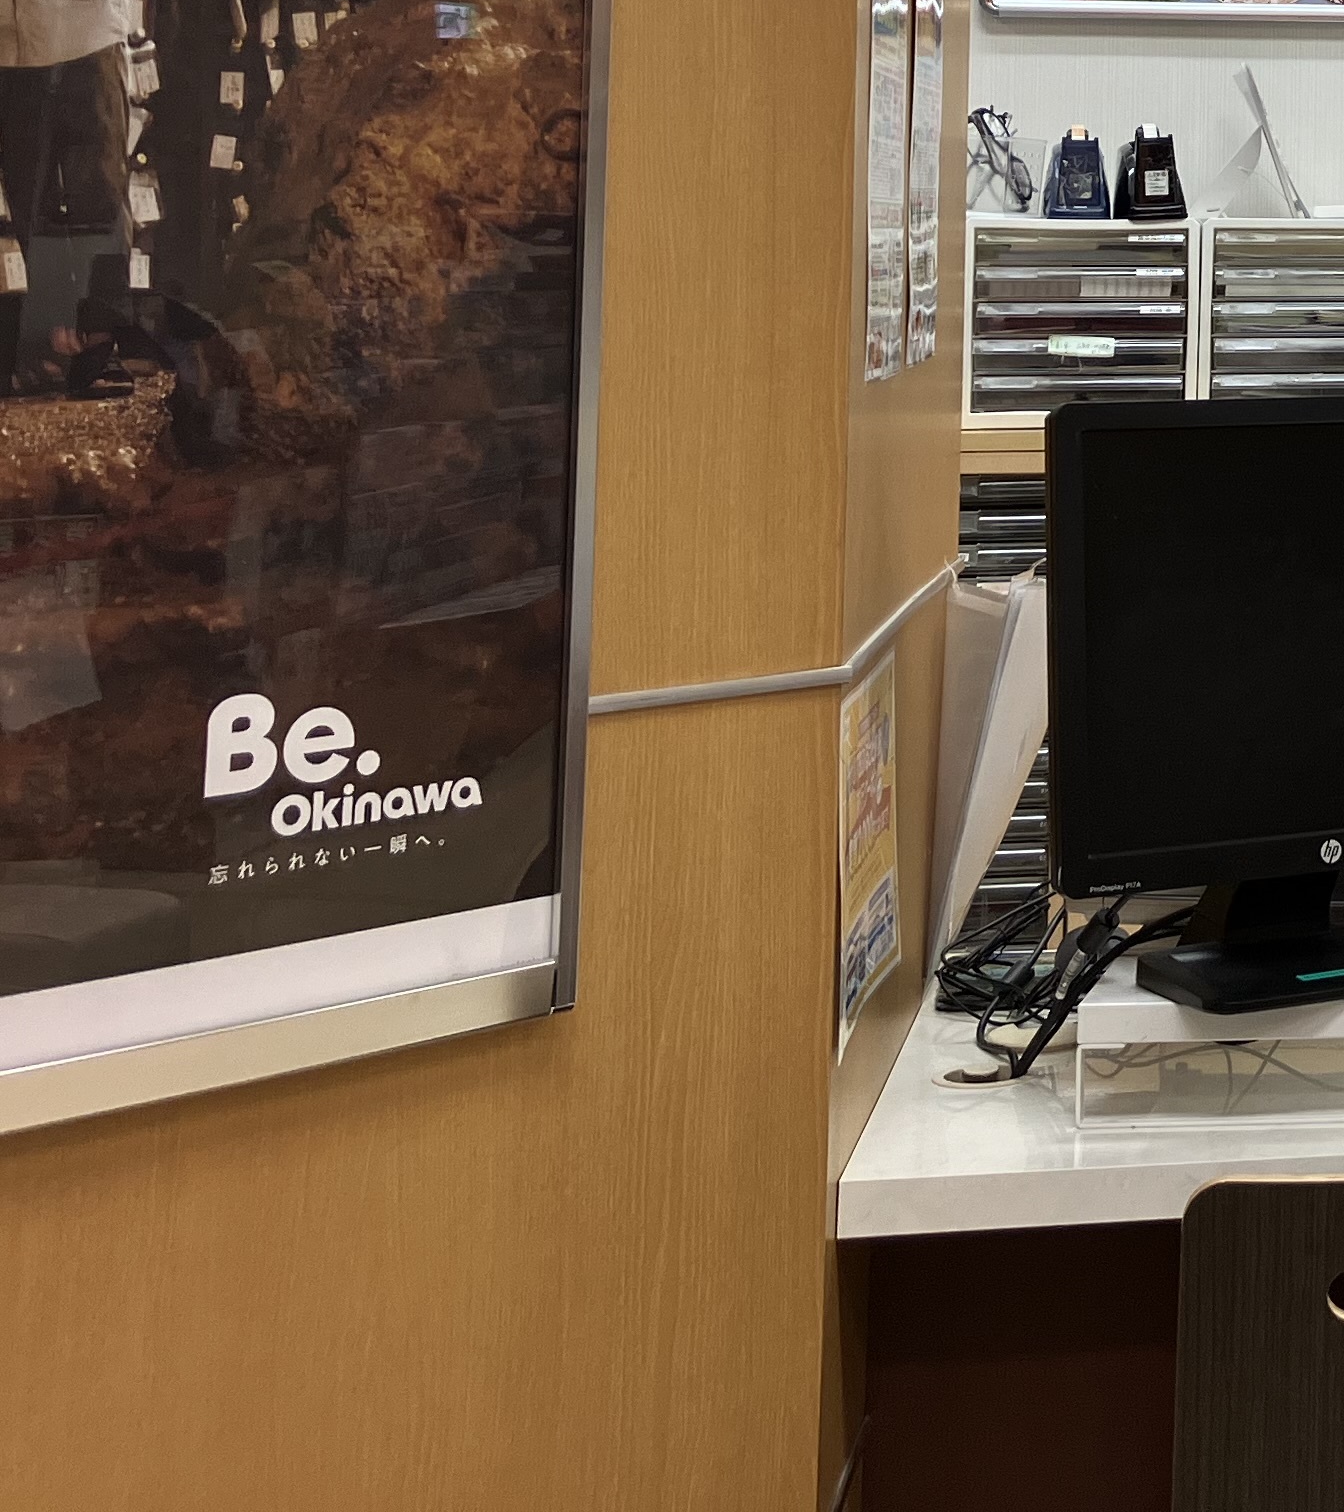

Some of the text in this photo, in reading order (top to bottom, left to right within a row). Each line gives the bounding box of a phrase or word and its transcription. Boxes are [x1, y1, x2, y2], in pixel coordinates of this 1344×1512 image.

[204, 693, 381, 799] Be.
[271, 775, 483, 837] Okinawa
[208, 833, 446, 886] 忘れられない一瞬へ。
[1321, 839, 1342, 864] hp
